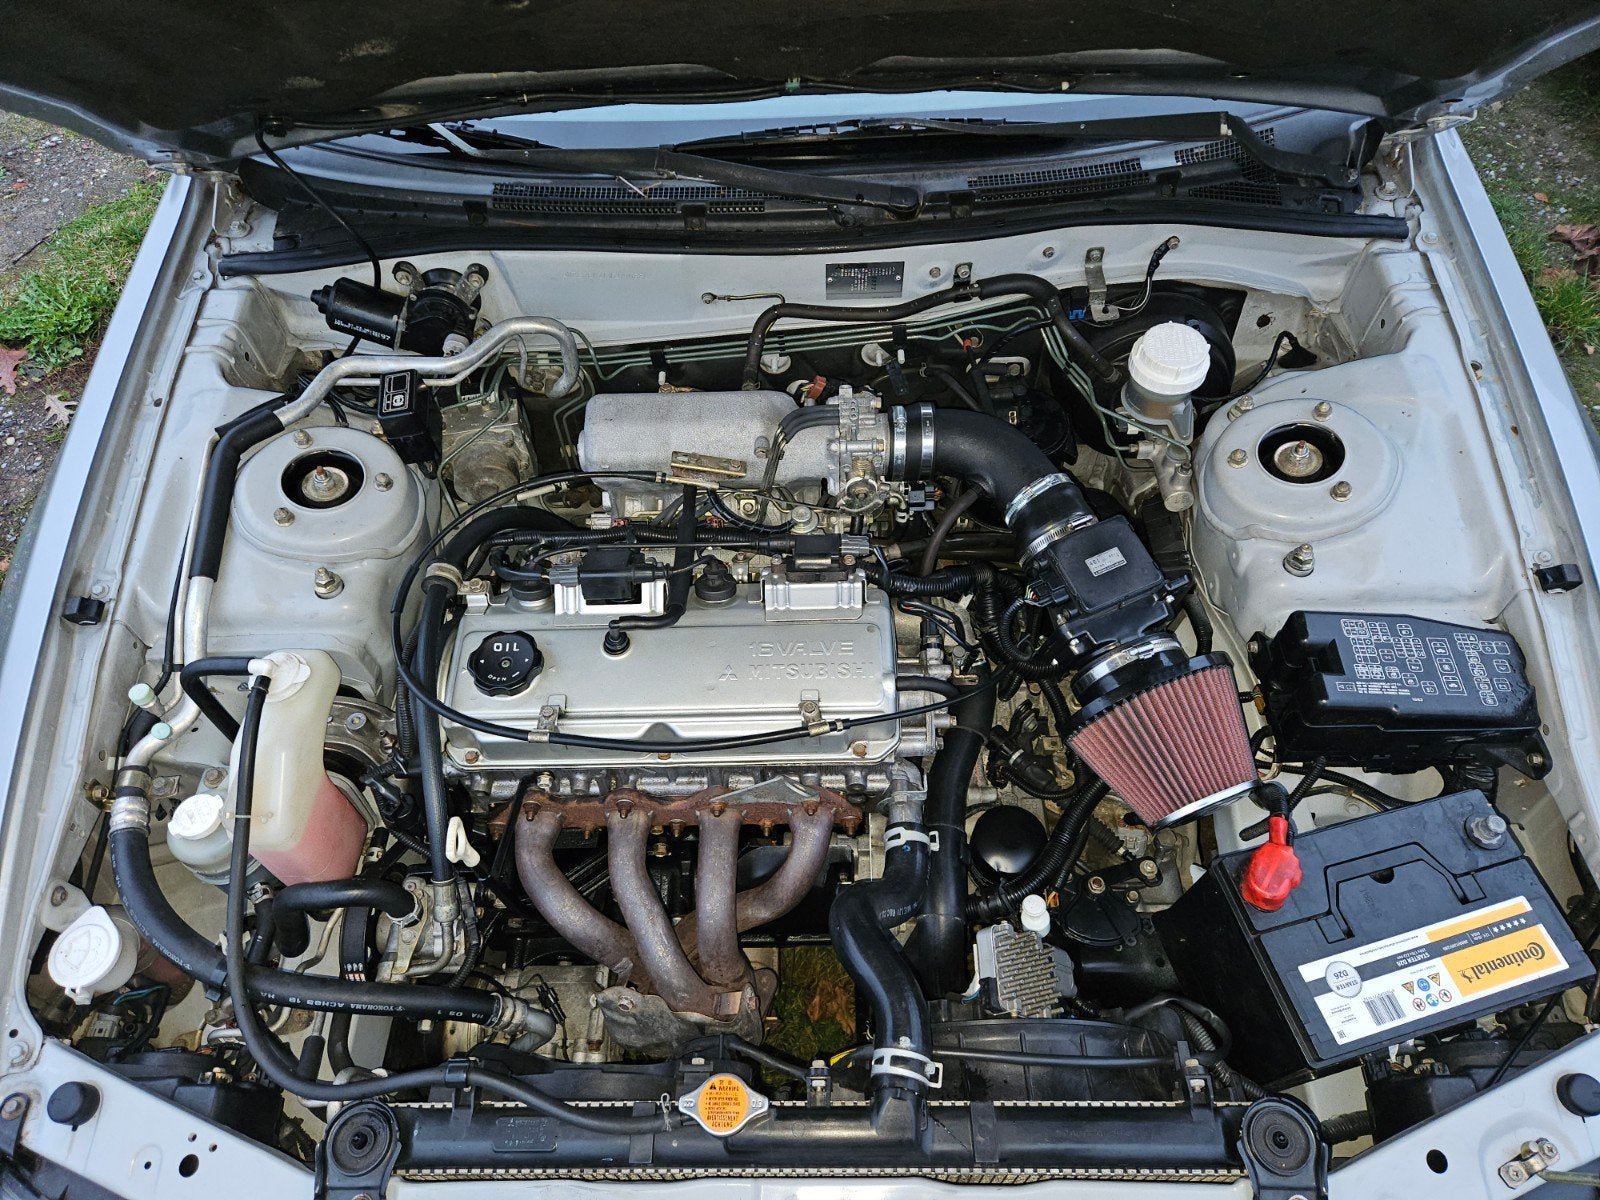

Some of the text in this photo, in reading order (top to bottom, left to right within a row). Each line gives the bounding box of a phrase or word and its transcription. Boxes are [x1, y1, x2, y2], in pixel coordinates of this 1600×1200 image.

[493, 642, 520, 652] OIL
[749, 662, 874, 680] MITSUBISHI
[487, 673, 507, 682] OPEN
[1471, 941, 1546, 980] Continental
[1333, 969, 1349, 980] D26
[1335, 978, 1359, 991] STARTER
[350, 1003, 394, 1011] YOKOHAMA
